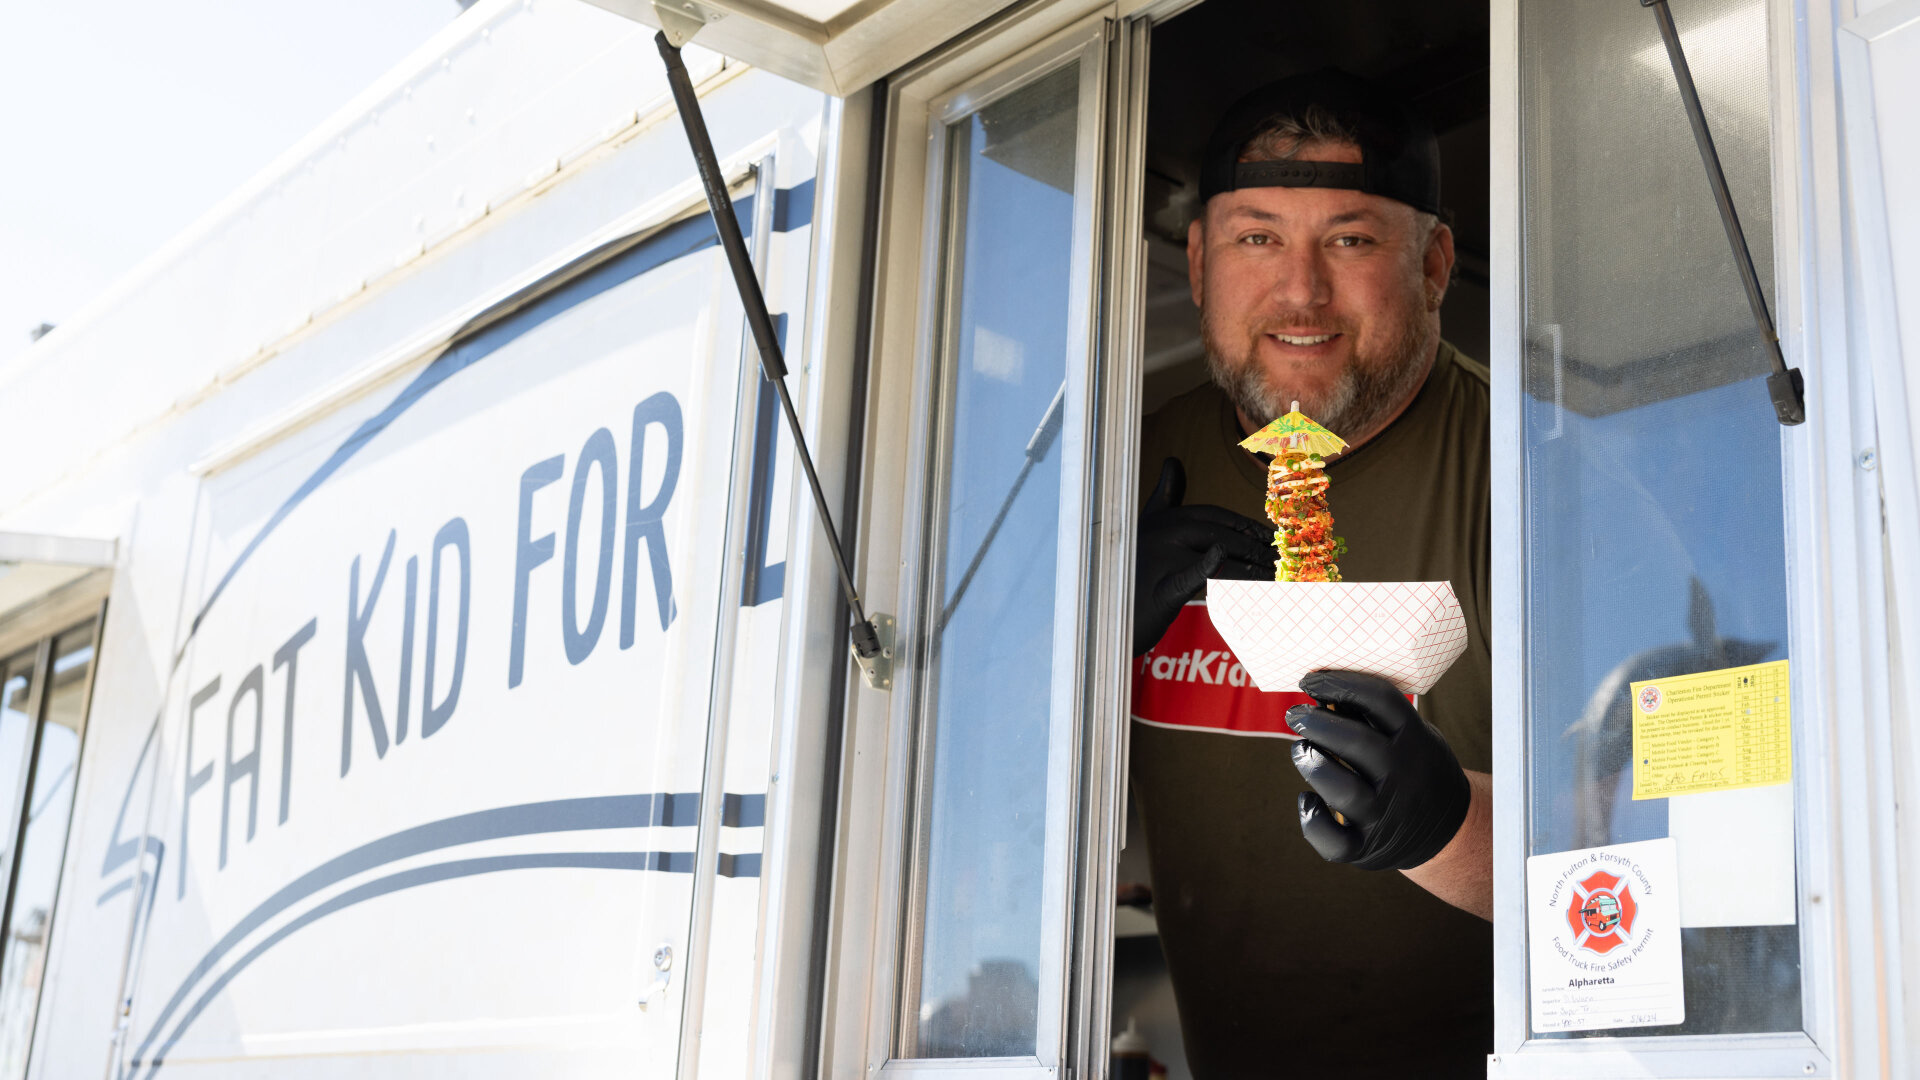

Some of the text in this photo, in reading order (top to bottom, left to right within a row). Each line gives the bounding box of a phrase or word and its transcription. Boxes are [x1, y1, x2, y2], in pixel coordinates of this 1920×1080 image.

[177, 617, 317, 901] FAT
[340, 516, 471, 779] KID
[509, 391, 684, 690] FOR
[1703, 682, 1731, 691] Department
[1549, 852, 1652, 907] North Fulton & Forsyth County
[1552, 928, 1654, 972] Food Truck Fire Safety Permit
[1568, 977, 1615, 989] Alpharetta
